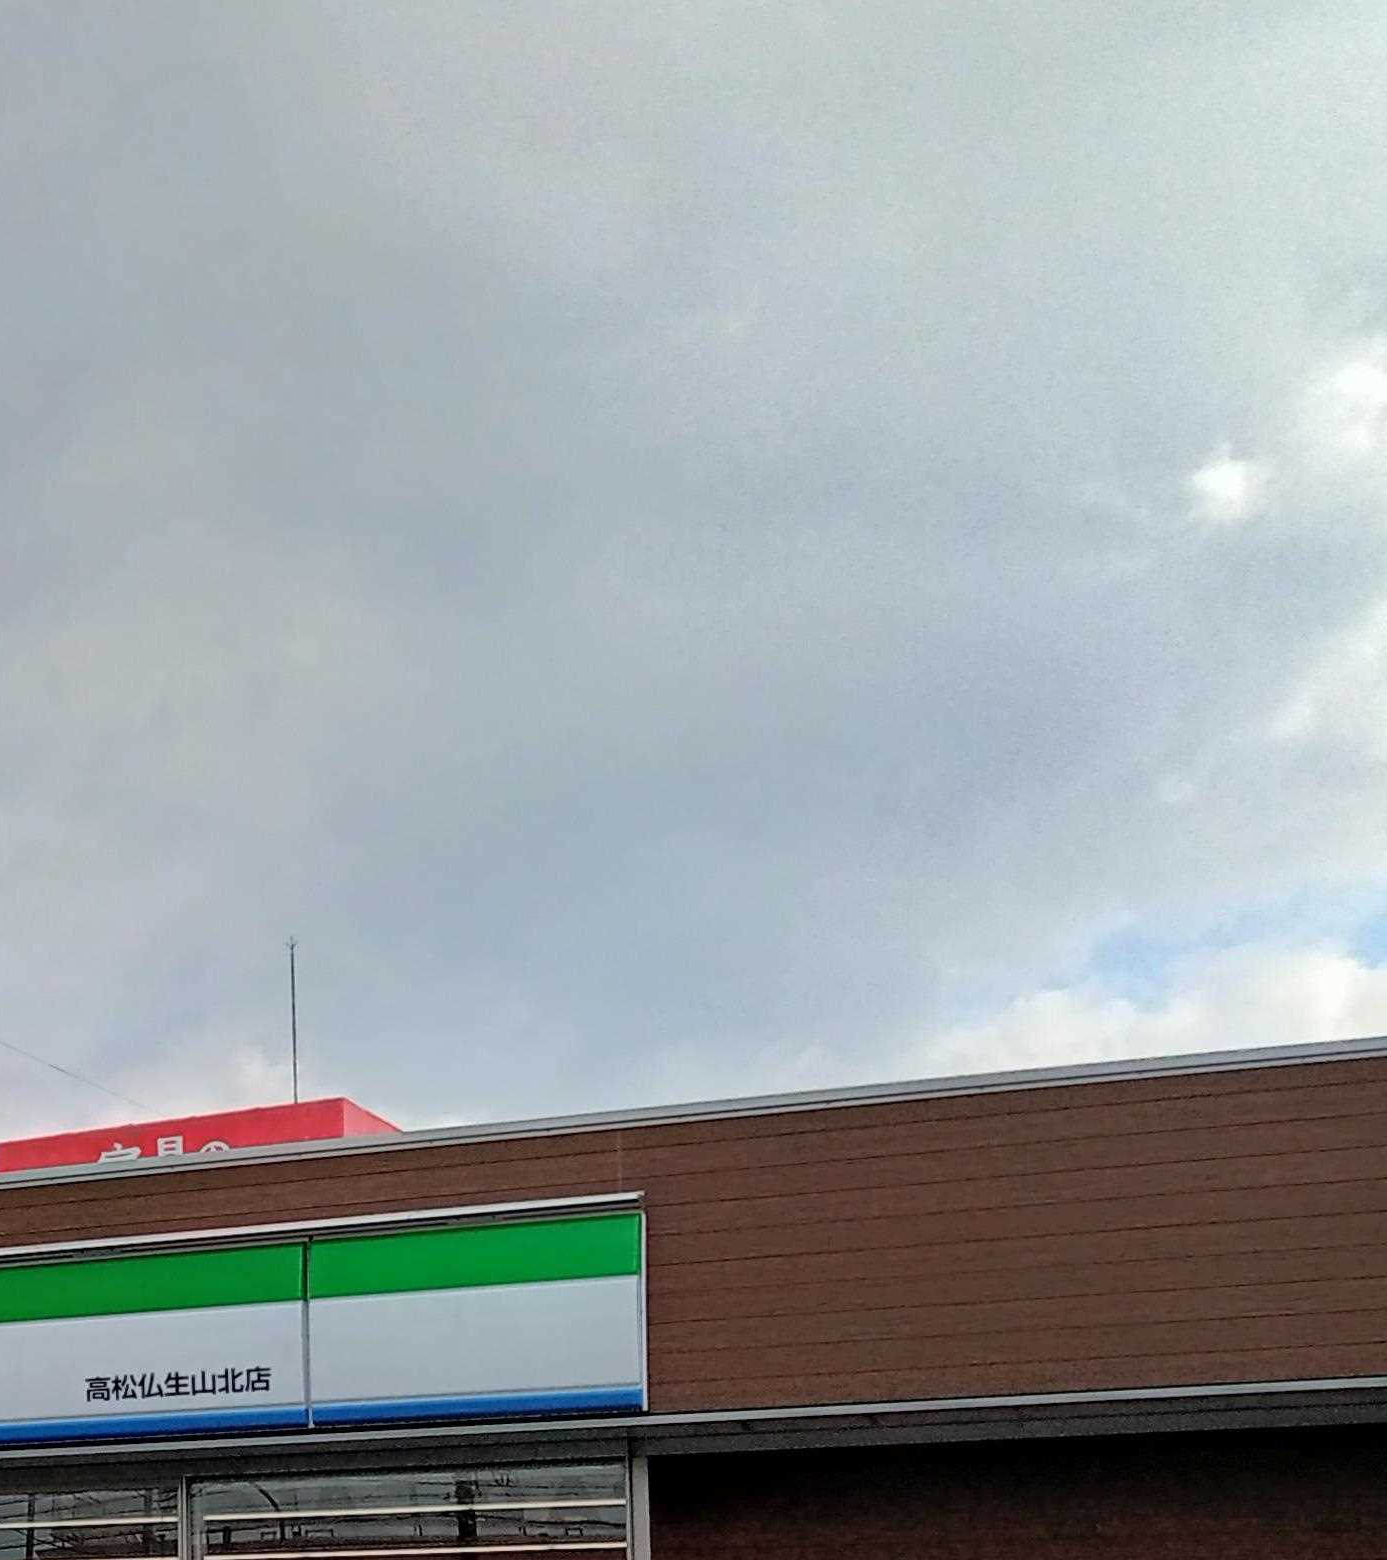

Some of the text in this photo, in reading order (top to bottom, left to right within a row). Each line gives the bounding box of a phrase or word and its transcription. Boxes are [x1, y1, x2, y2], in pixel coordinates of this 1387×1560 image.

[85, 1366, 272, 1402] 高松仏生山北店
